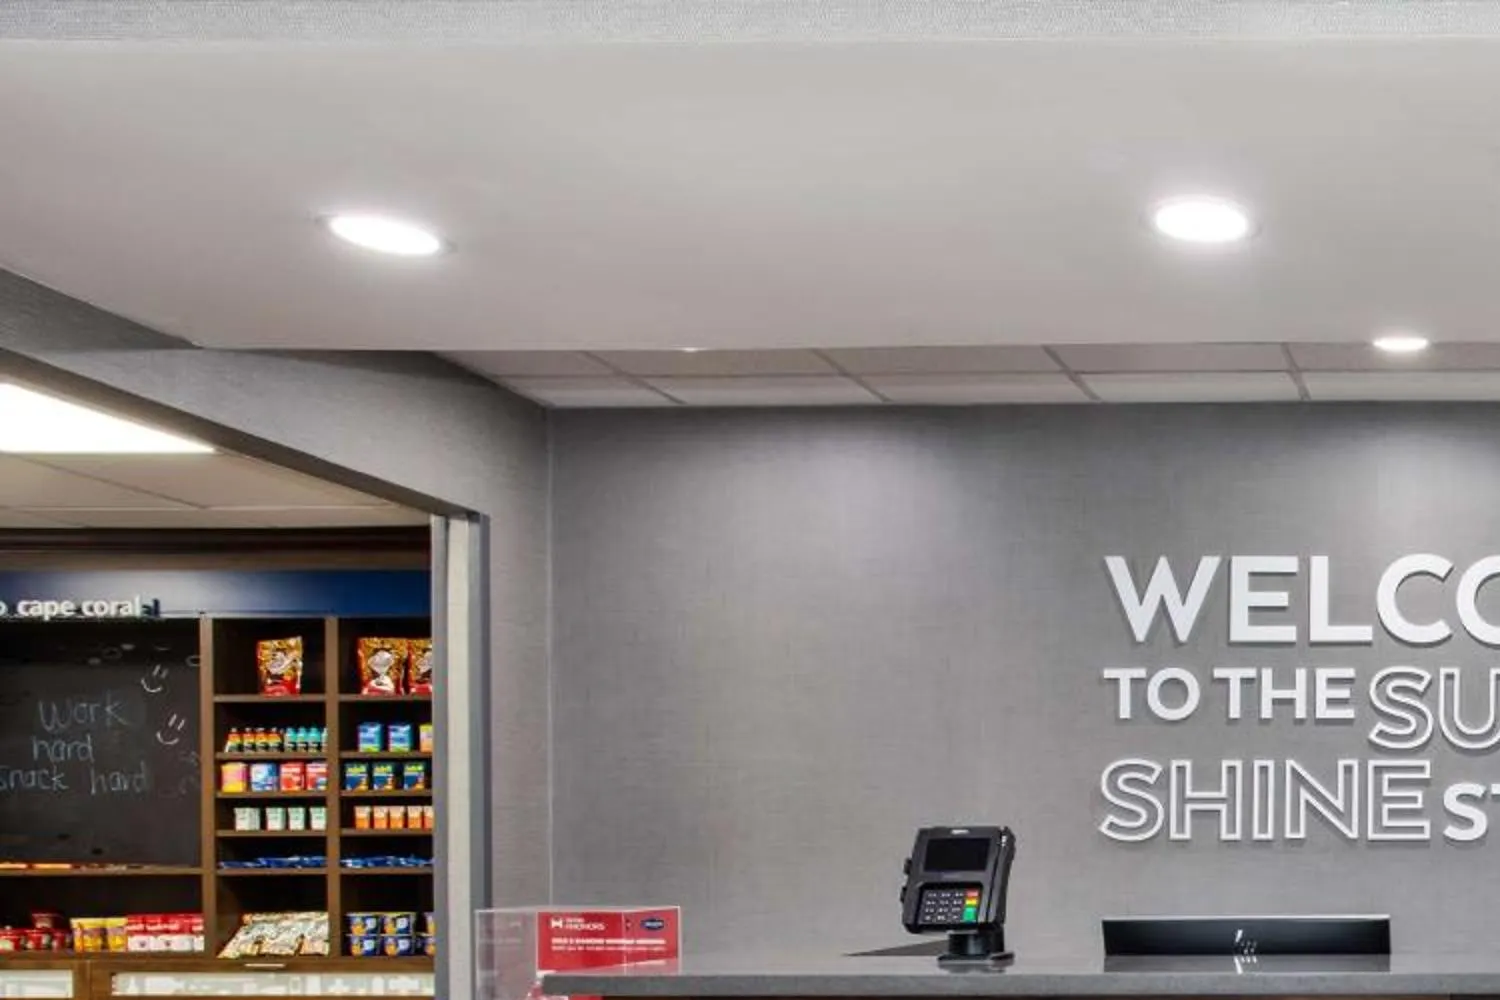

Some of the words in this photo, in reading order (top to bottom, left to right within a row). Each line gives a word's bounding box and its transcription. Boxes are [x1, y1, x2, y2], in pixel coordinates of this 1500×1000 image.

[17, 600, 76, 621] cape
[81, 595, 142, 617] coral
[1103, 667, 1201, 721] TO
[1213, 667, 1356, 721] THE
[32, 733, 95, 762] hard
[1099, 759, 1431, 841] SHINE
